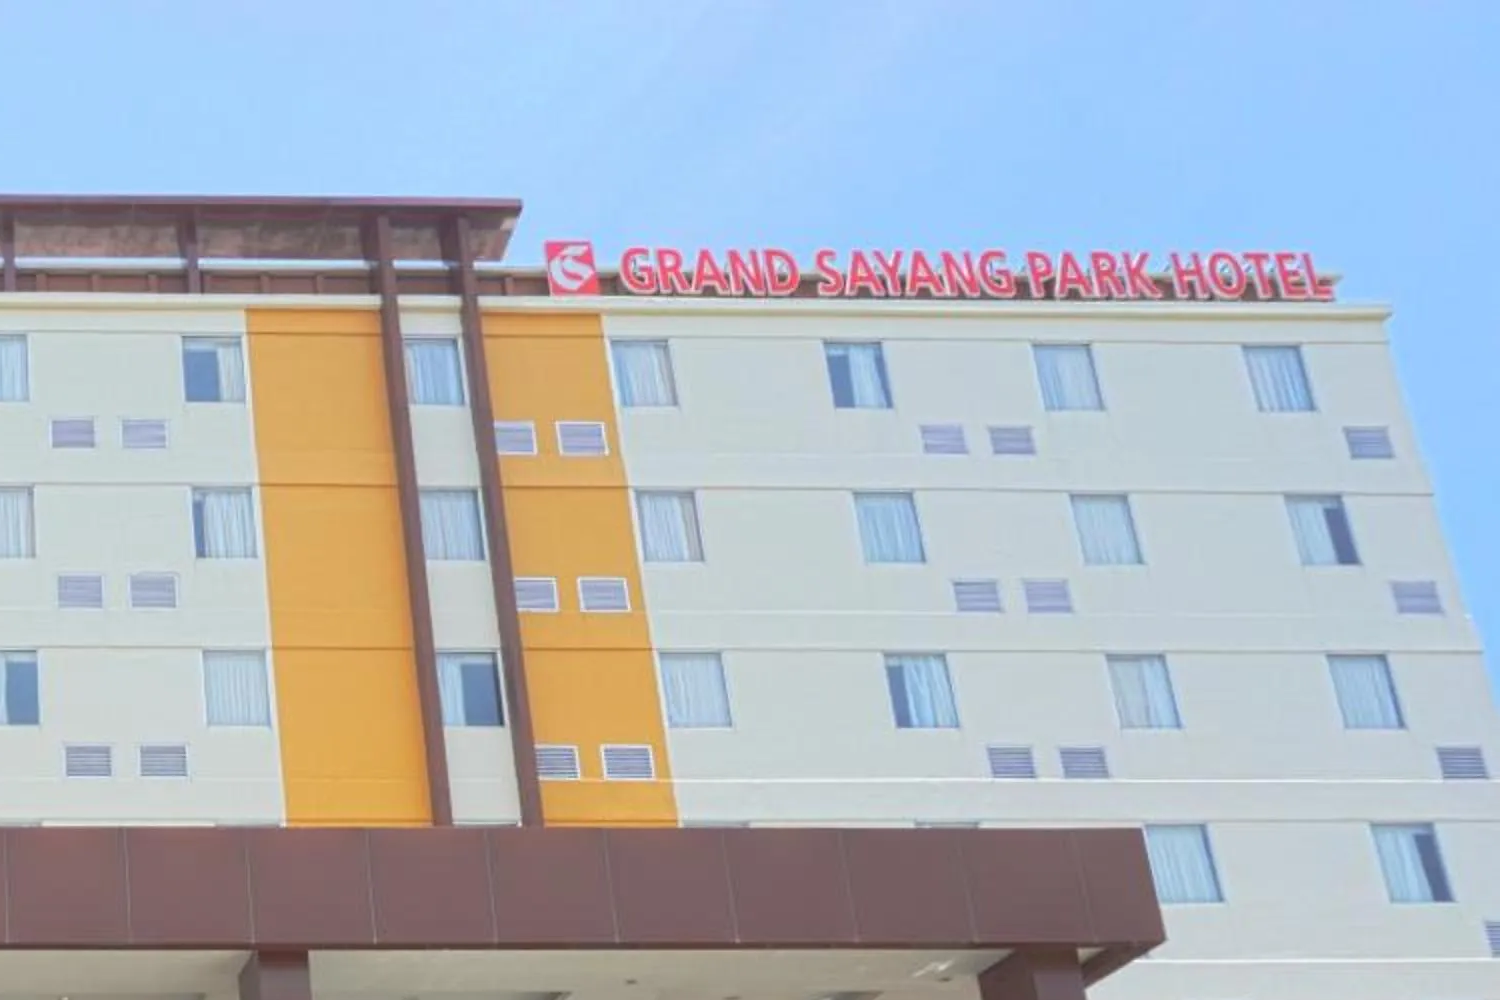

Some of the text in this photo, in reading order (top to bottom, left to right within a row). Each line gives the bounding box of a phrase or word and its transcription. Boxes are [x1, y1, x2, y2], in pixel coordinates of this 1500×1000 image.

[620, 247, 1335, 301] GRAND SAYANG PARK HOTEL
